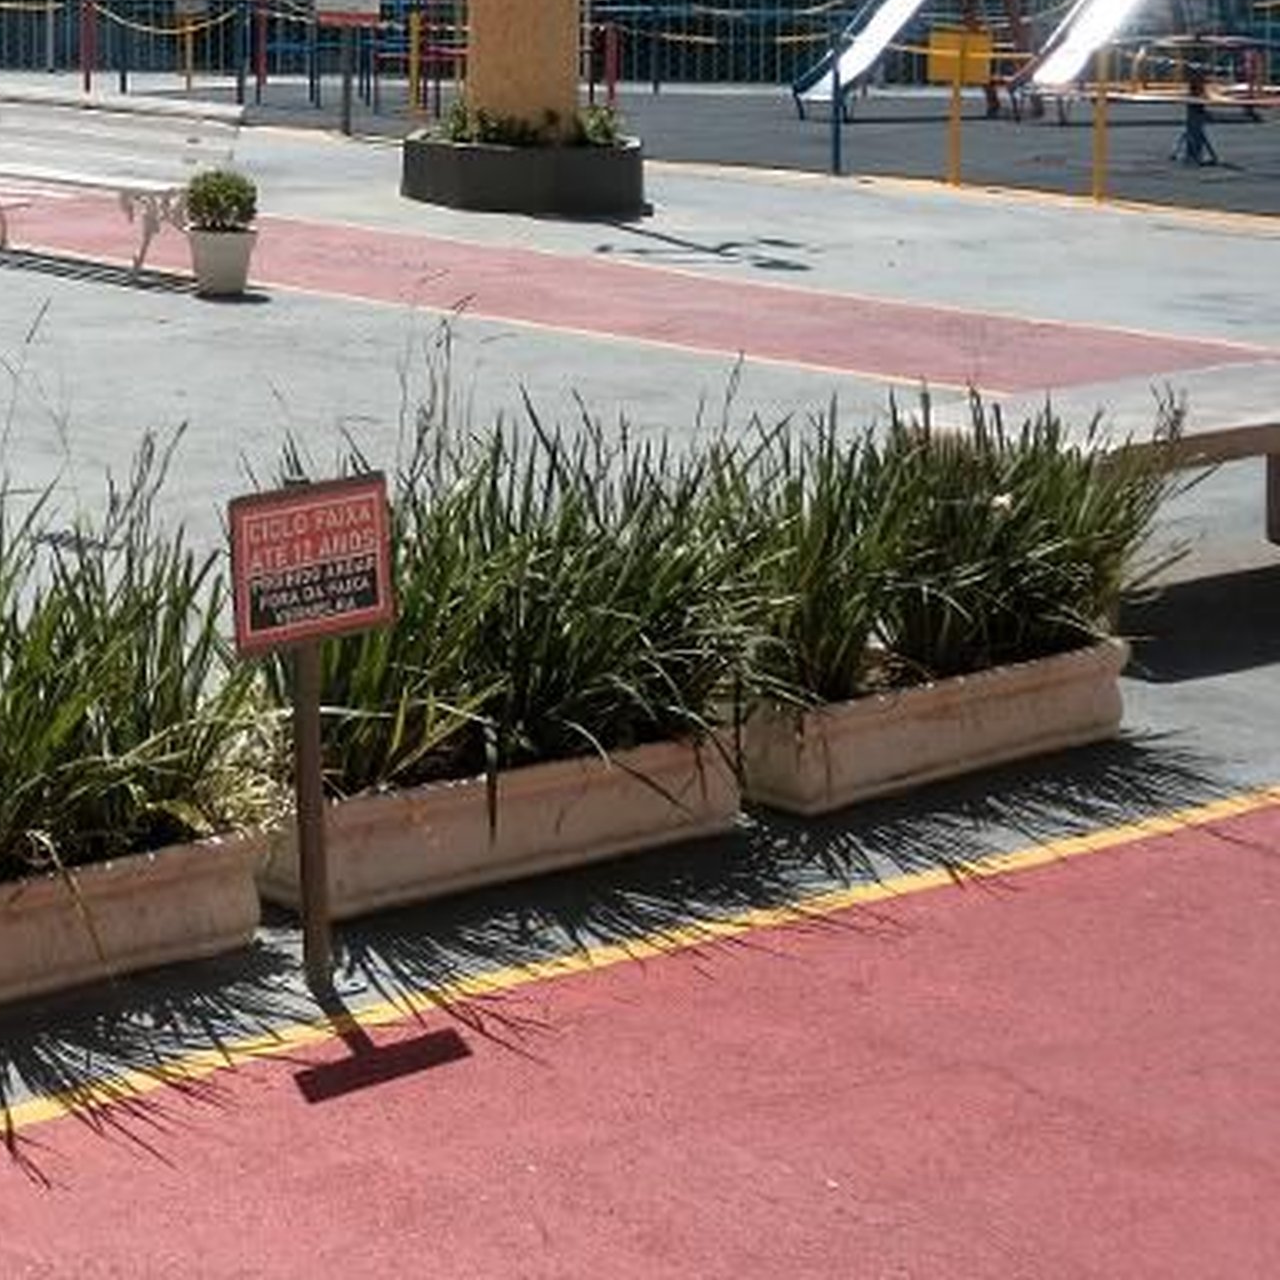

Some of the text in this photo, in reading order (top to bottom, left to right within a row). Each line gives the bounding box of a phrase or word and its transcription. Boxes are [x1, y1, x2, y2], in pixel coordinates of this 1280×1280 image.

[249, 504, 371, 545] CICLO FAIXA
[319, 527, 376, 556] ANOS
